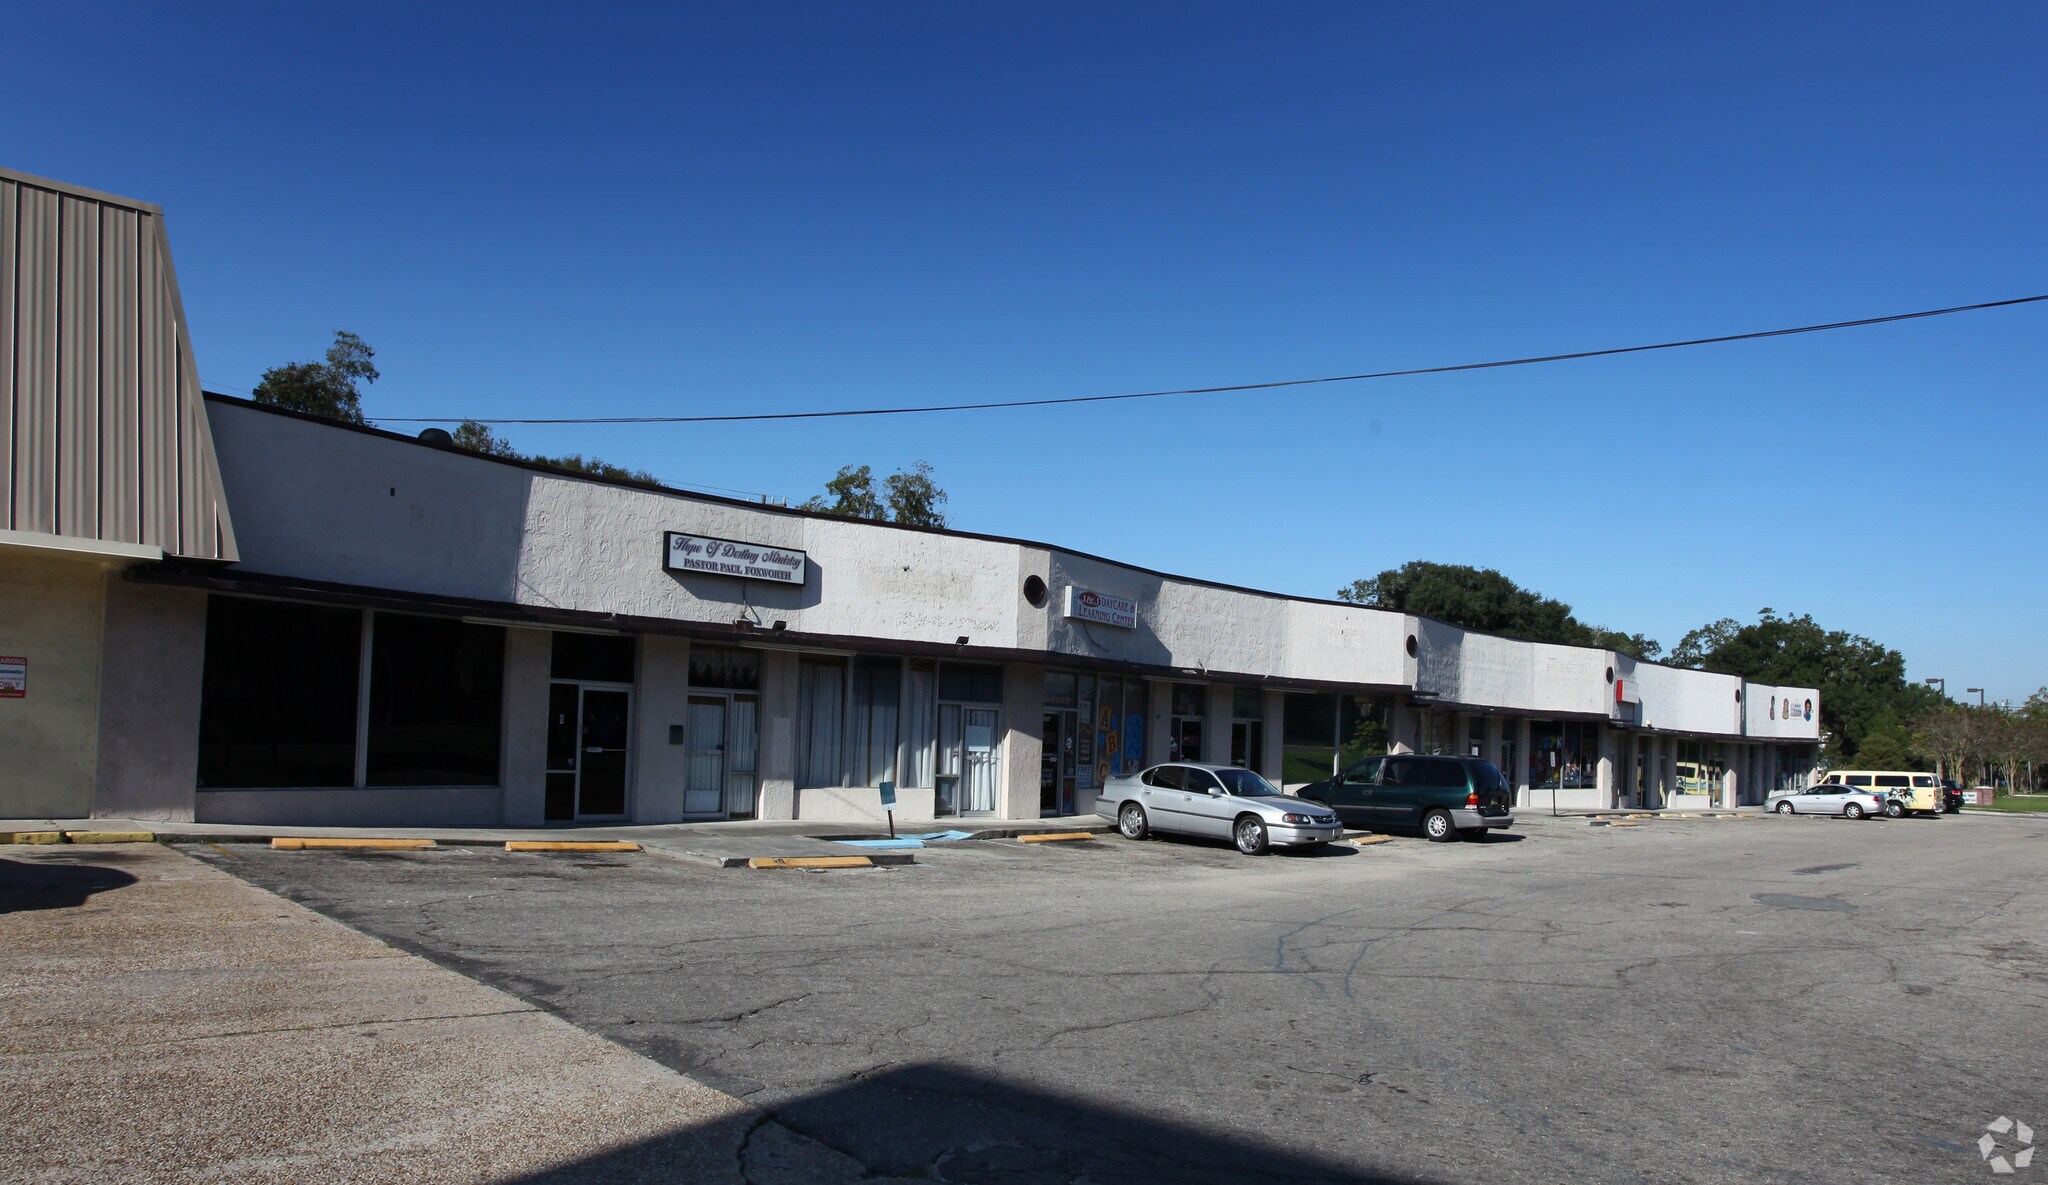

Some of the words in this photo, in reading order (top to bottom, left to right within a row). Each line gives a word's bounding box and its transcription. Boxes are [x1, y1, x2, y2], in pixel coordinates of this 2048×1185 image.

[673, 537, 702, 556] Hope
[706, 541, 723, 558] Of
[721, 544, 759, 564] Destiny
[761, 550, 802, 570] Ministry
[683, 558, 719, 571] PASTOR
[720, 563, 742, 575] PAUL
[744, 566, 792, 580] FOXWORTH
[1081, 594, 1099, 605] J&J
[1101, 598, 1128, 612] DAYCARE
[1130, 604, 1135, 612] &
[1079, 604, 1110, 622] LEARNING
[1101, 708, 1109, 727] A
[1108, 735, 1116, 753] B
